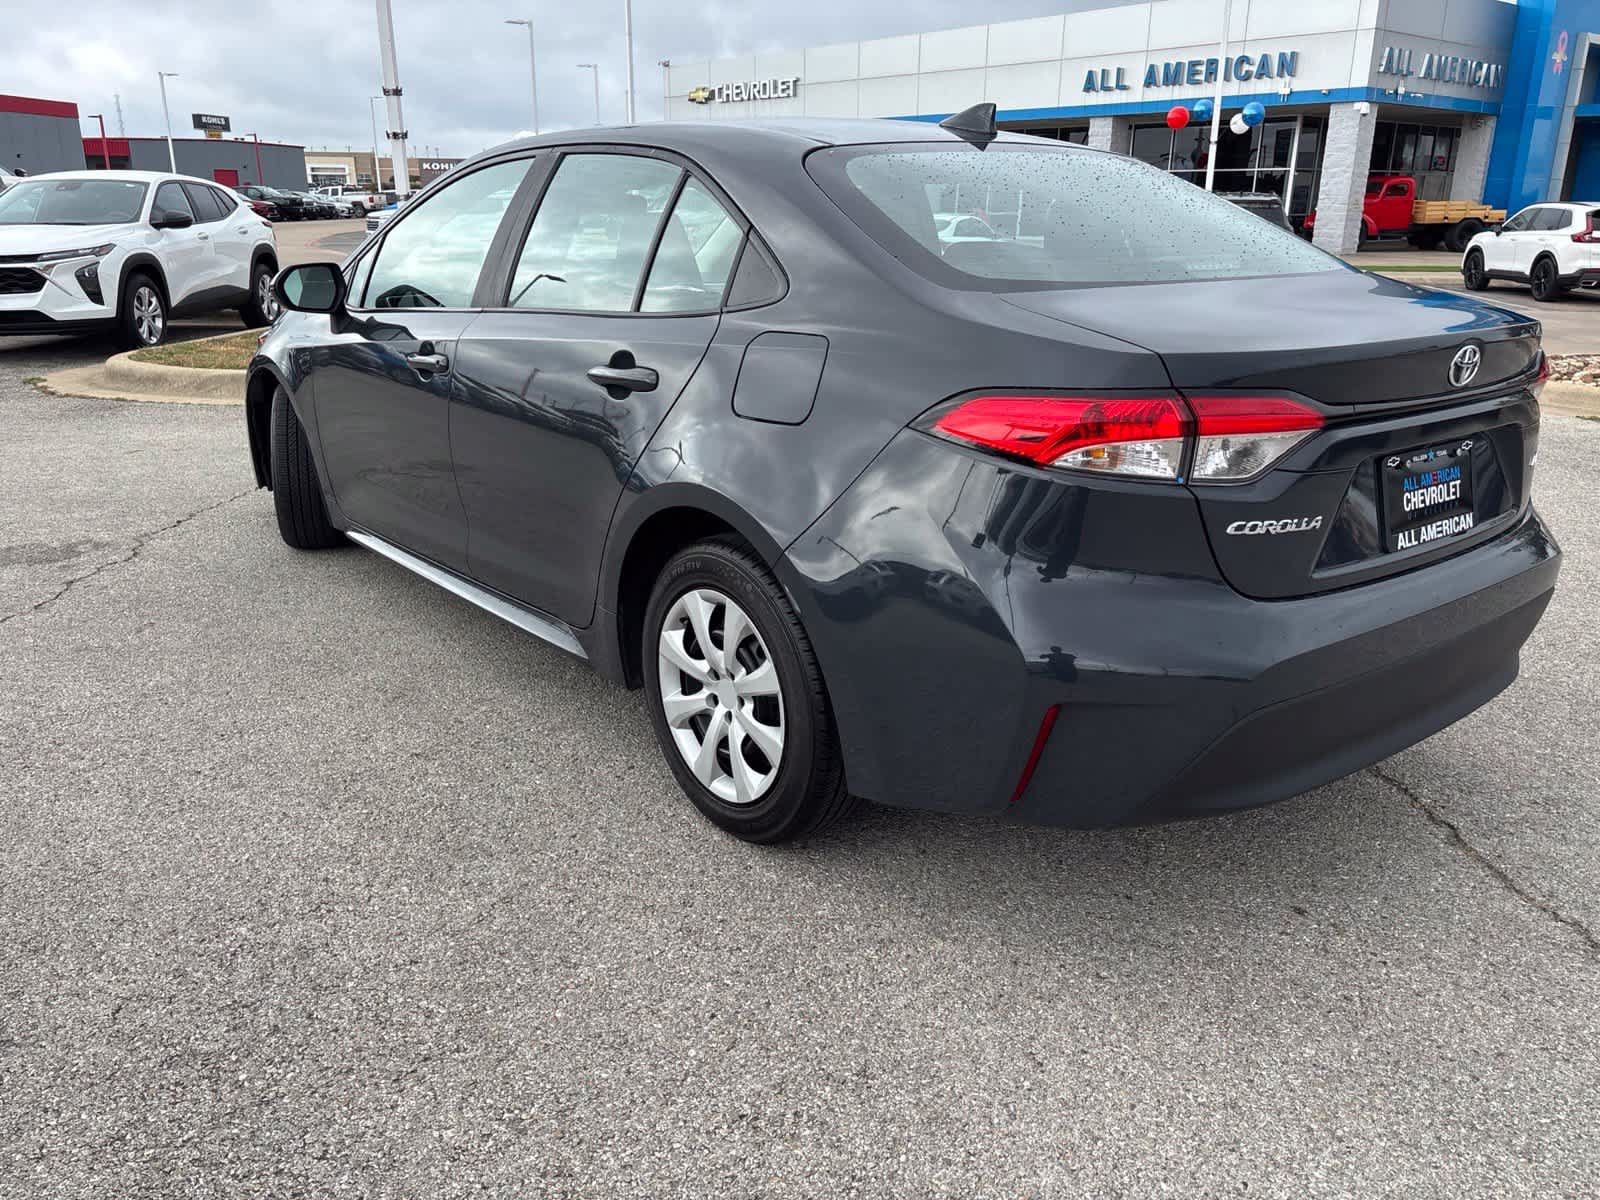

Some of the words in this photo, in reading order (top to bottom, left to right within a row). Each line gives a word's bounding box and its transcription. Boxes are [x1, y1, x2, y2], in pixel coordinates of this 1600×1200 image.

[1082, 67, 1129, 92] ALL
[1143, 51, 1299, 88] AMERICAN
[1377, 46, 1414, 76] ALL
[1417, 53, 1504, 88] AMERICAN
[714, 78, 799, 103] CHEVROLET
[1403, 476, 1417, 491] ALL
[1421, 465, 1461, 487] AMERICAN
[1403, 480, 1461, 512] CHEVROLET
[1226, 516, 1322, 534] COROLLA
[1398, 532, 1418, 550] ALL
[1420, 512, 1474, 544] AMERICAN
